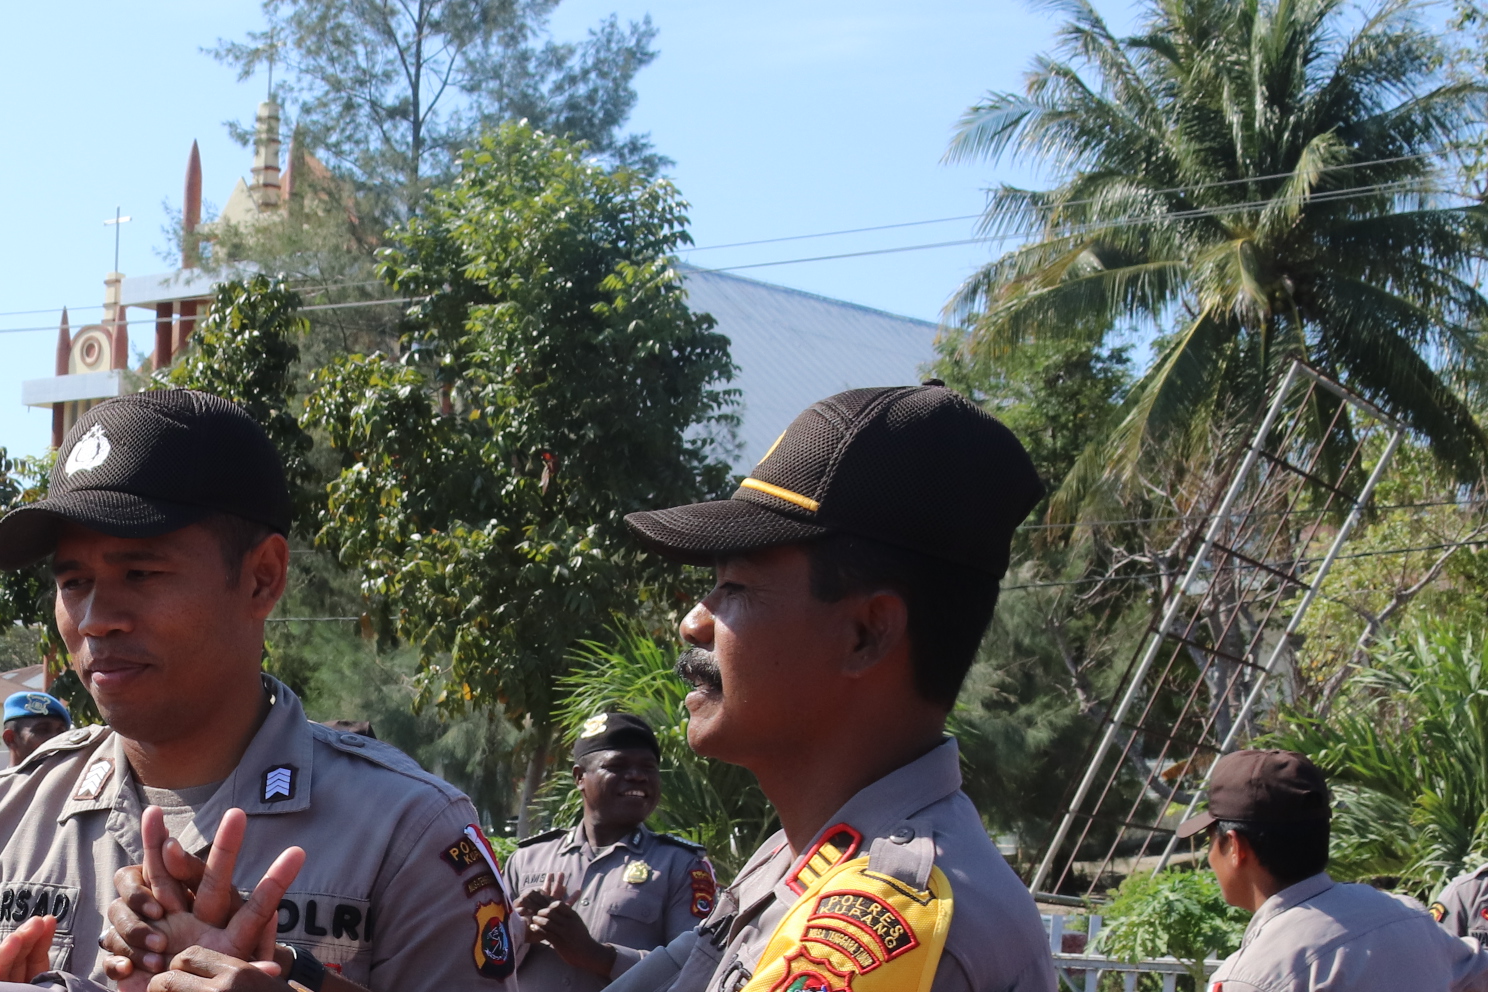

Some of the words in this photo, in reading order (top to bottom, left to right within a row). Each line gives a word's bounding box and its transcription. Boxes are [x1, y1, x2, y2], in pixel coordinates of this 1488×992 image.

[276, 898, 372, 943] OLRI
[818, 904, 897, 949] KUPANG
[827, 894, 905, 940] POLRES
